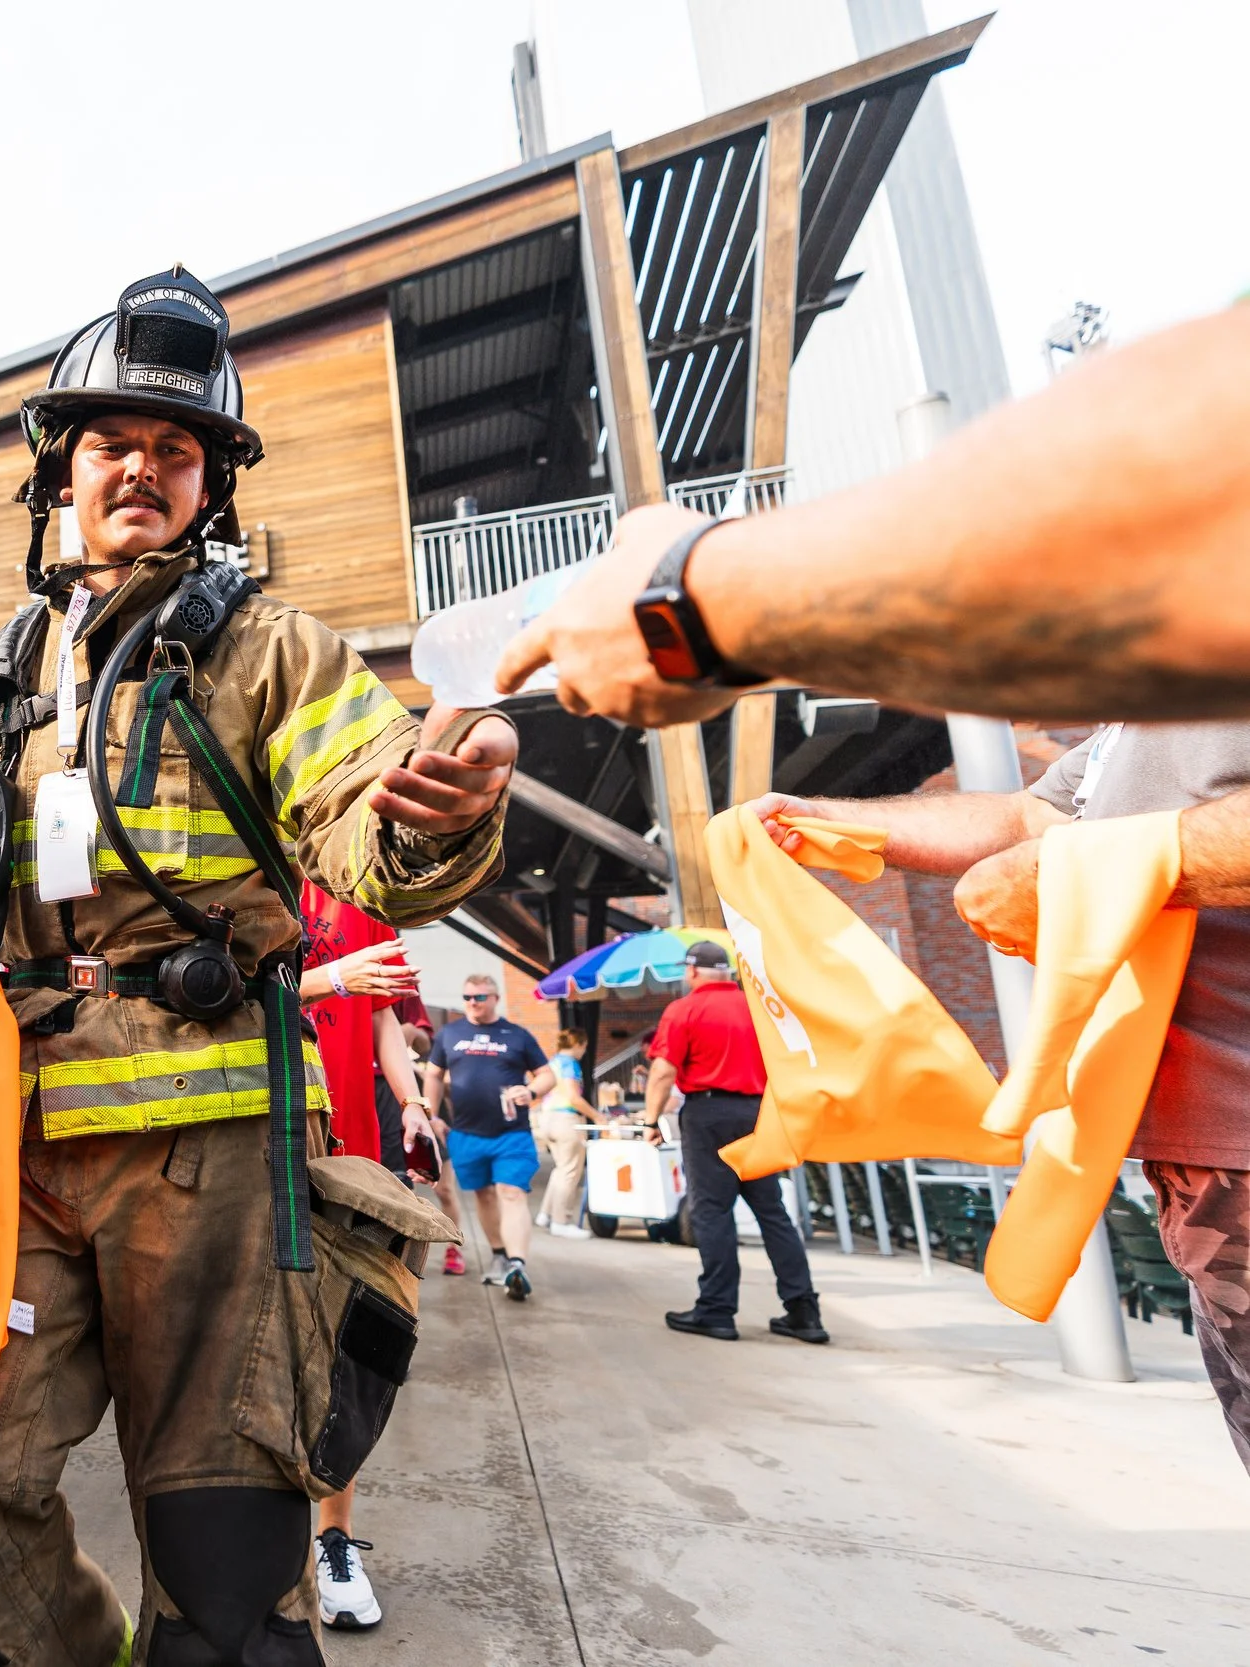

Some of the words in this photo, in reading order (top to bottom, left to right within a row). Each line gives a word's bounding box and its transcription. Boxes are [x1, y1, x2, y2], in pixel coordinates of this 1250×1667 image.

[132, 289, 157, 306] CITY
[162, 288, 178, 299] OF
[182, 292, 219, 325] MILTON
[126, 371, 204, 394] FIREFIGHTER
